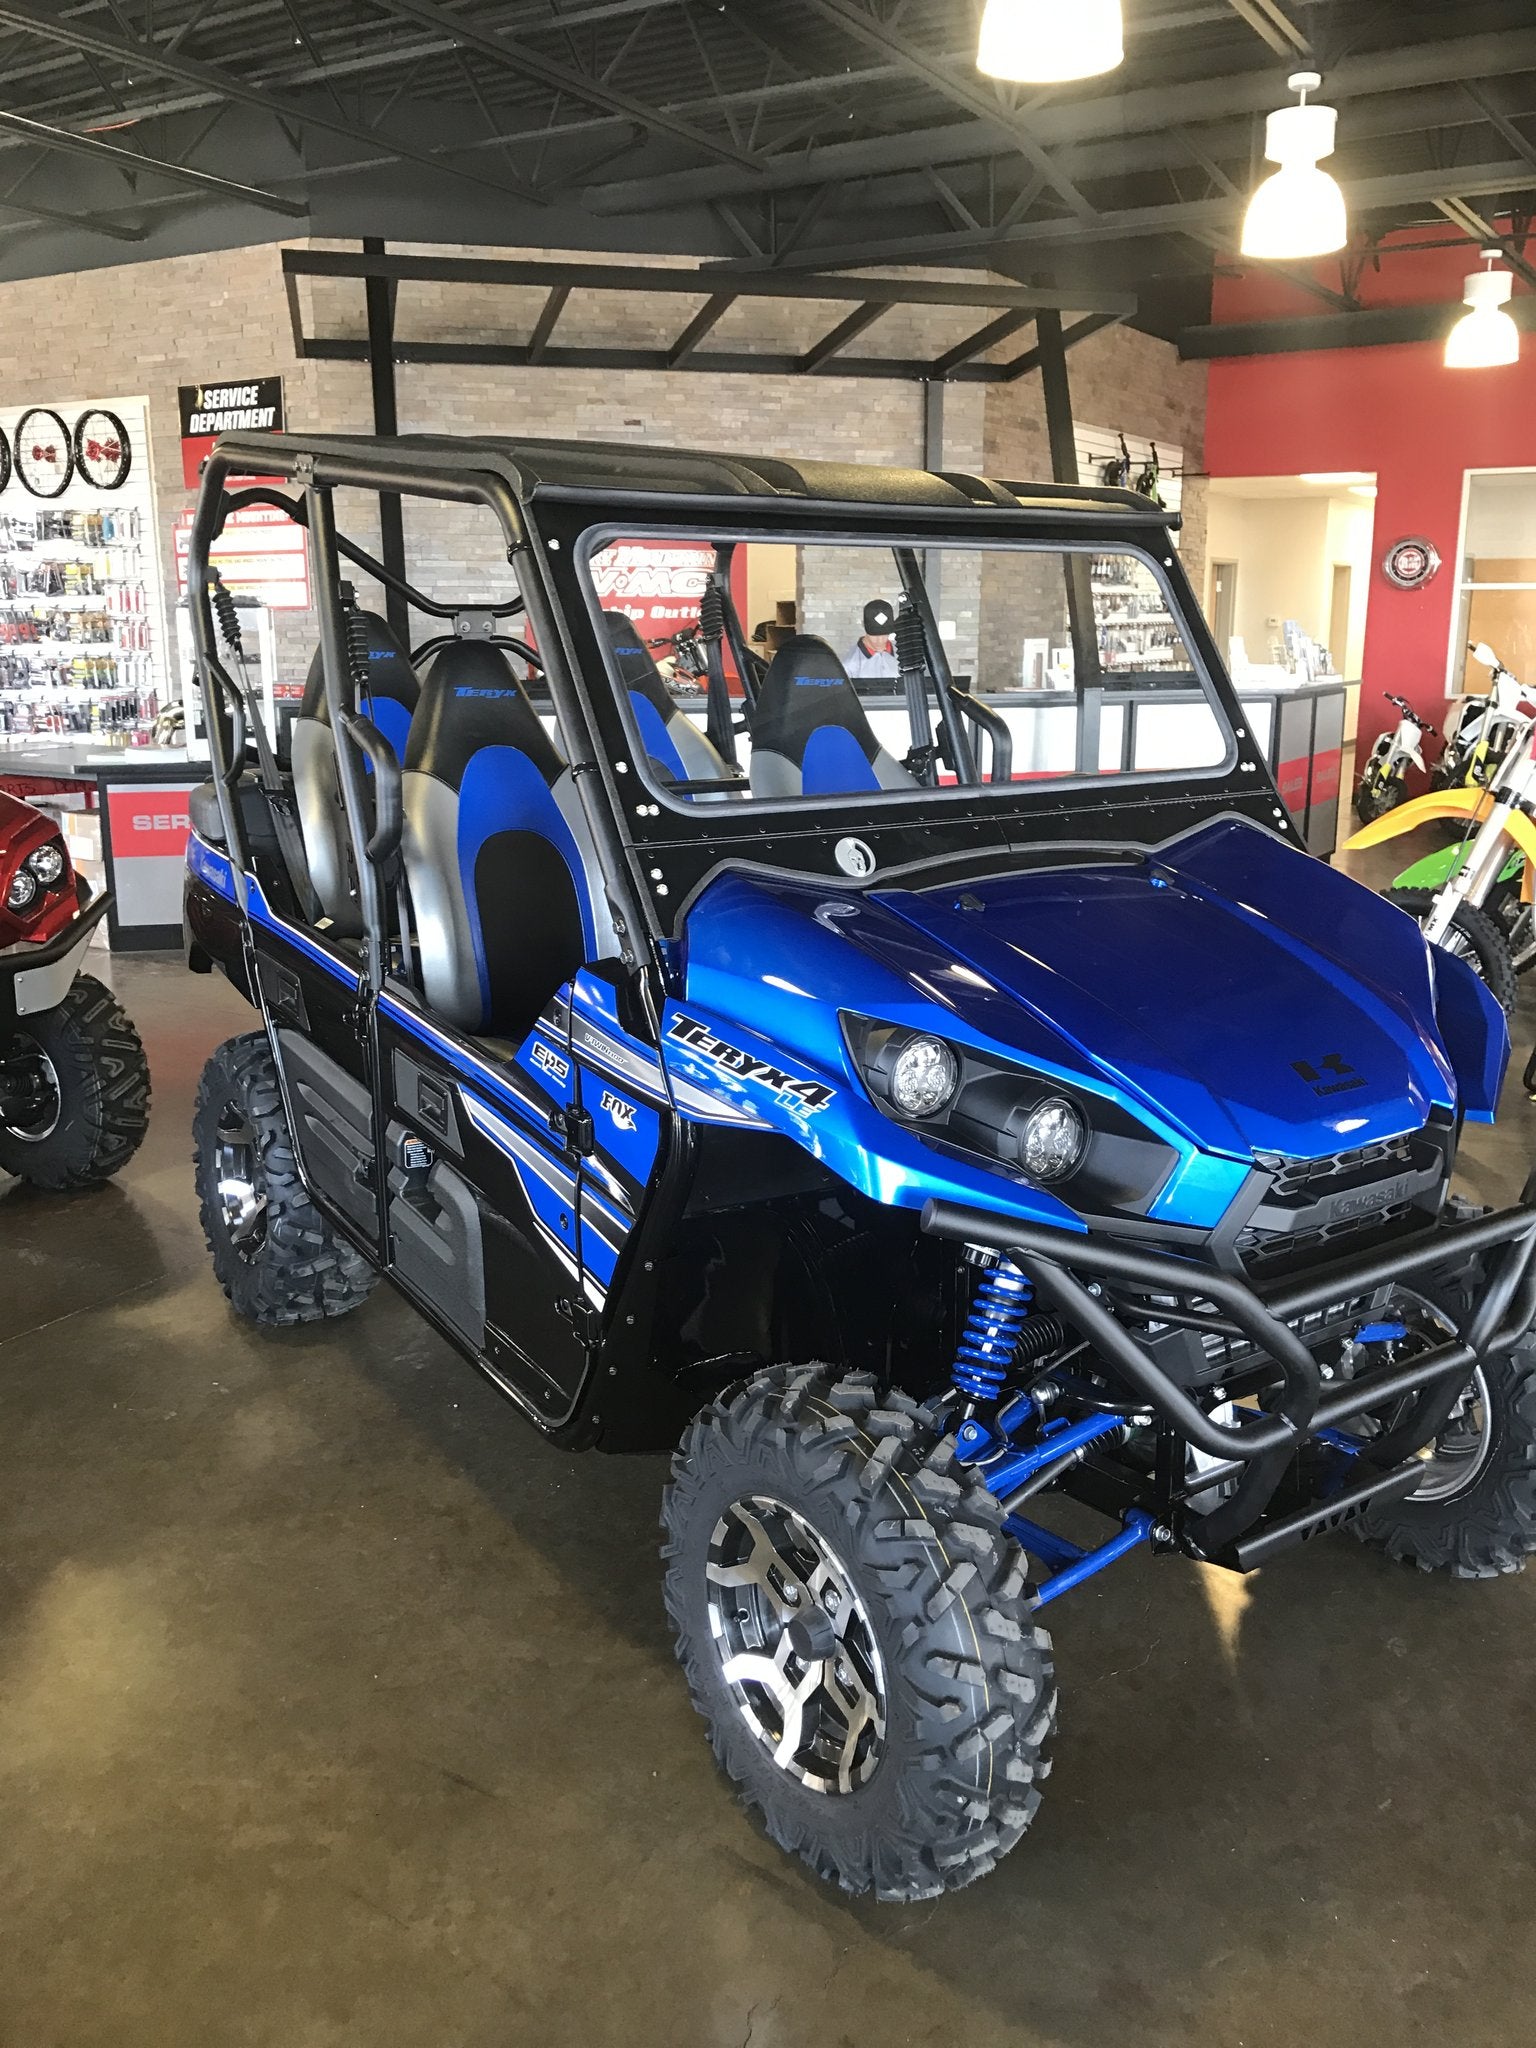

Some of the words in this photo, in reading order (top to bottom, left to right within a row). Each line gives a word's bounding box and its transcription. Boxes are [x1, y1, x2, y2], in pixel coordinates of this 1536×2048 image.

[203, 385, 259, 410] SERVICE
[189, 406, 276, 433] DEPARTMENT
[666, 1012, 837, 1111] TERYX4
[600, 1090, 637, 1123] FOX
[1330, 1179, 1409, 1218] Kawasaki
